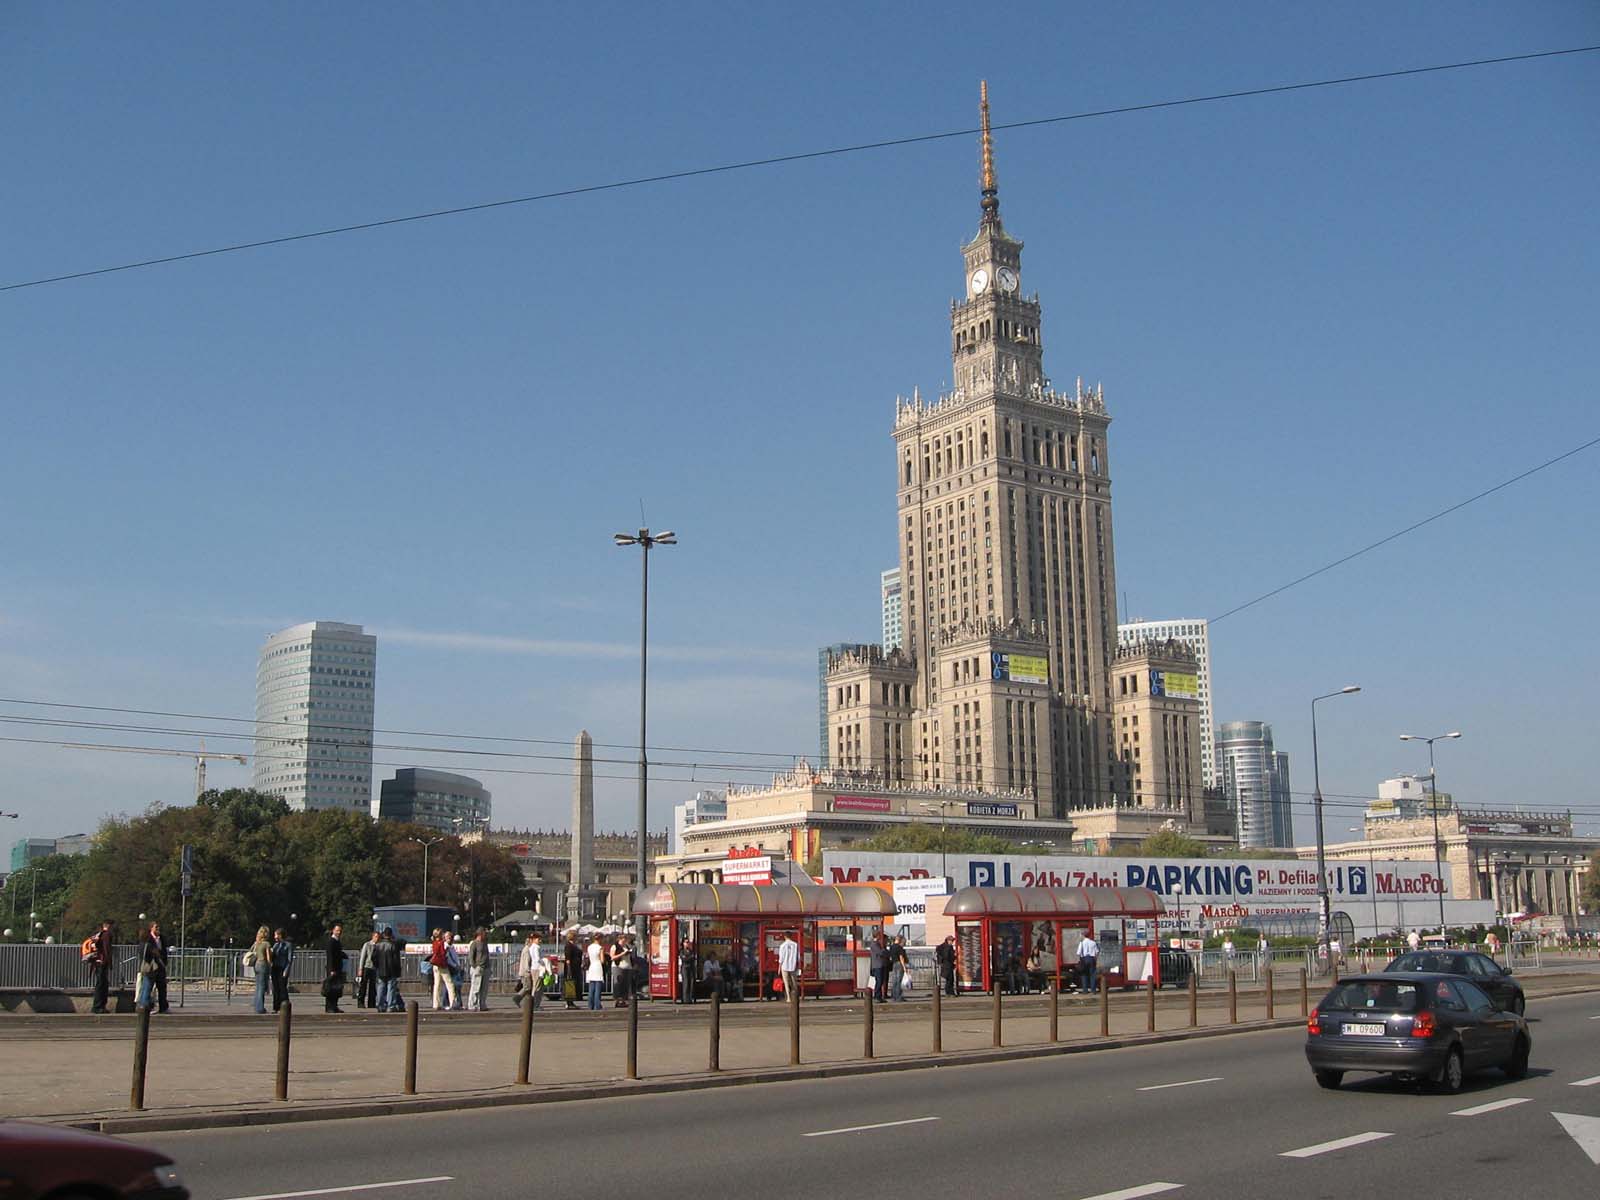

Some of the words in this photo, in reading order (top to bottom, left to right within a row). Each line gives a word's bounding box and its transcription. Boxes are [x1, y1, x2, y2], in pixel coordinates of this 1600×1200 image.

[1126, 865, 1253, 896] PARKING
[1278, 870, 1320, 885] Defila
[897, 904, 925, 914] STRÖE
[1359, 1025, 1384, 1034] 09600
